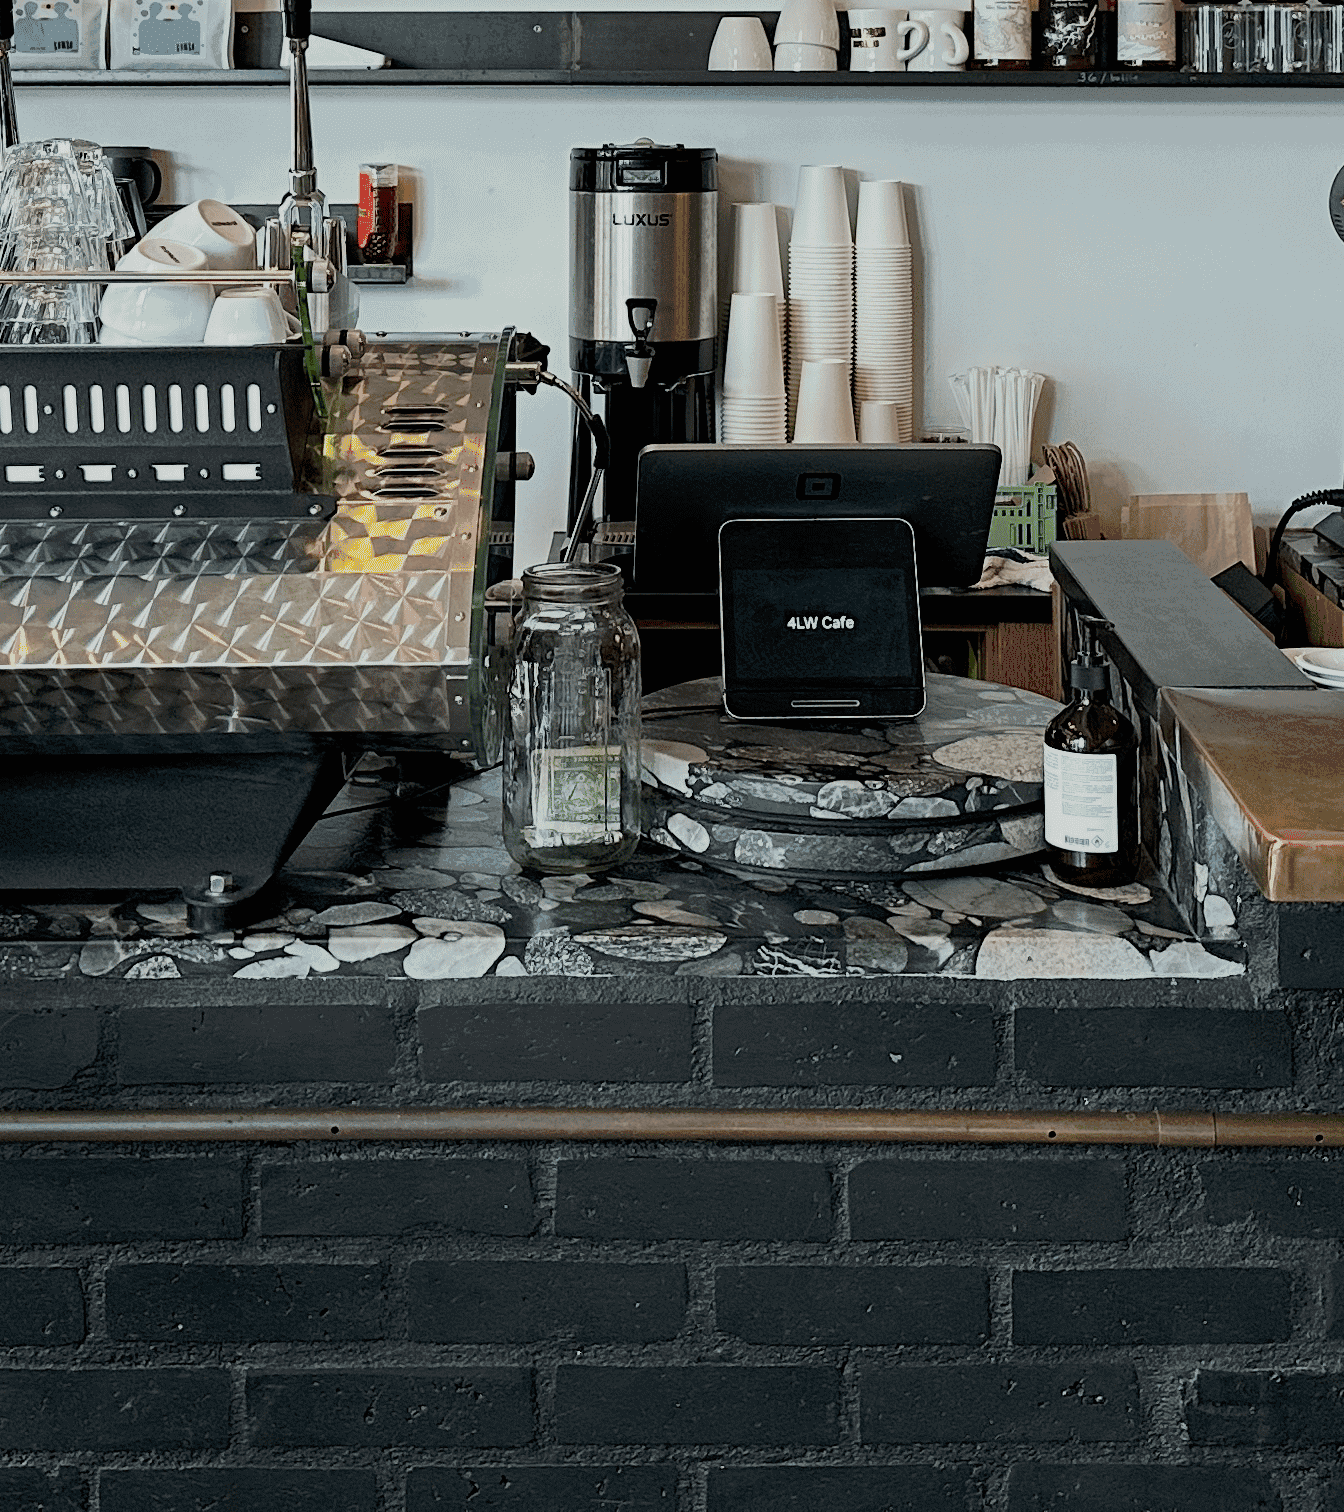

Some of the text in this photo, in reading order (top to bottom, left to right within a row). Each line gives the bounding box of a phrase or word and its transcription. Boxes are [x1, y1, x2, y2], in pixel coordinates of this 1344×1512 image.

[612, 213, 670, 226] LUXUS
[787, 615, 854, 630] 4LW Cafe
